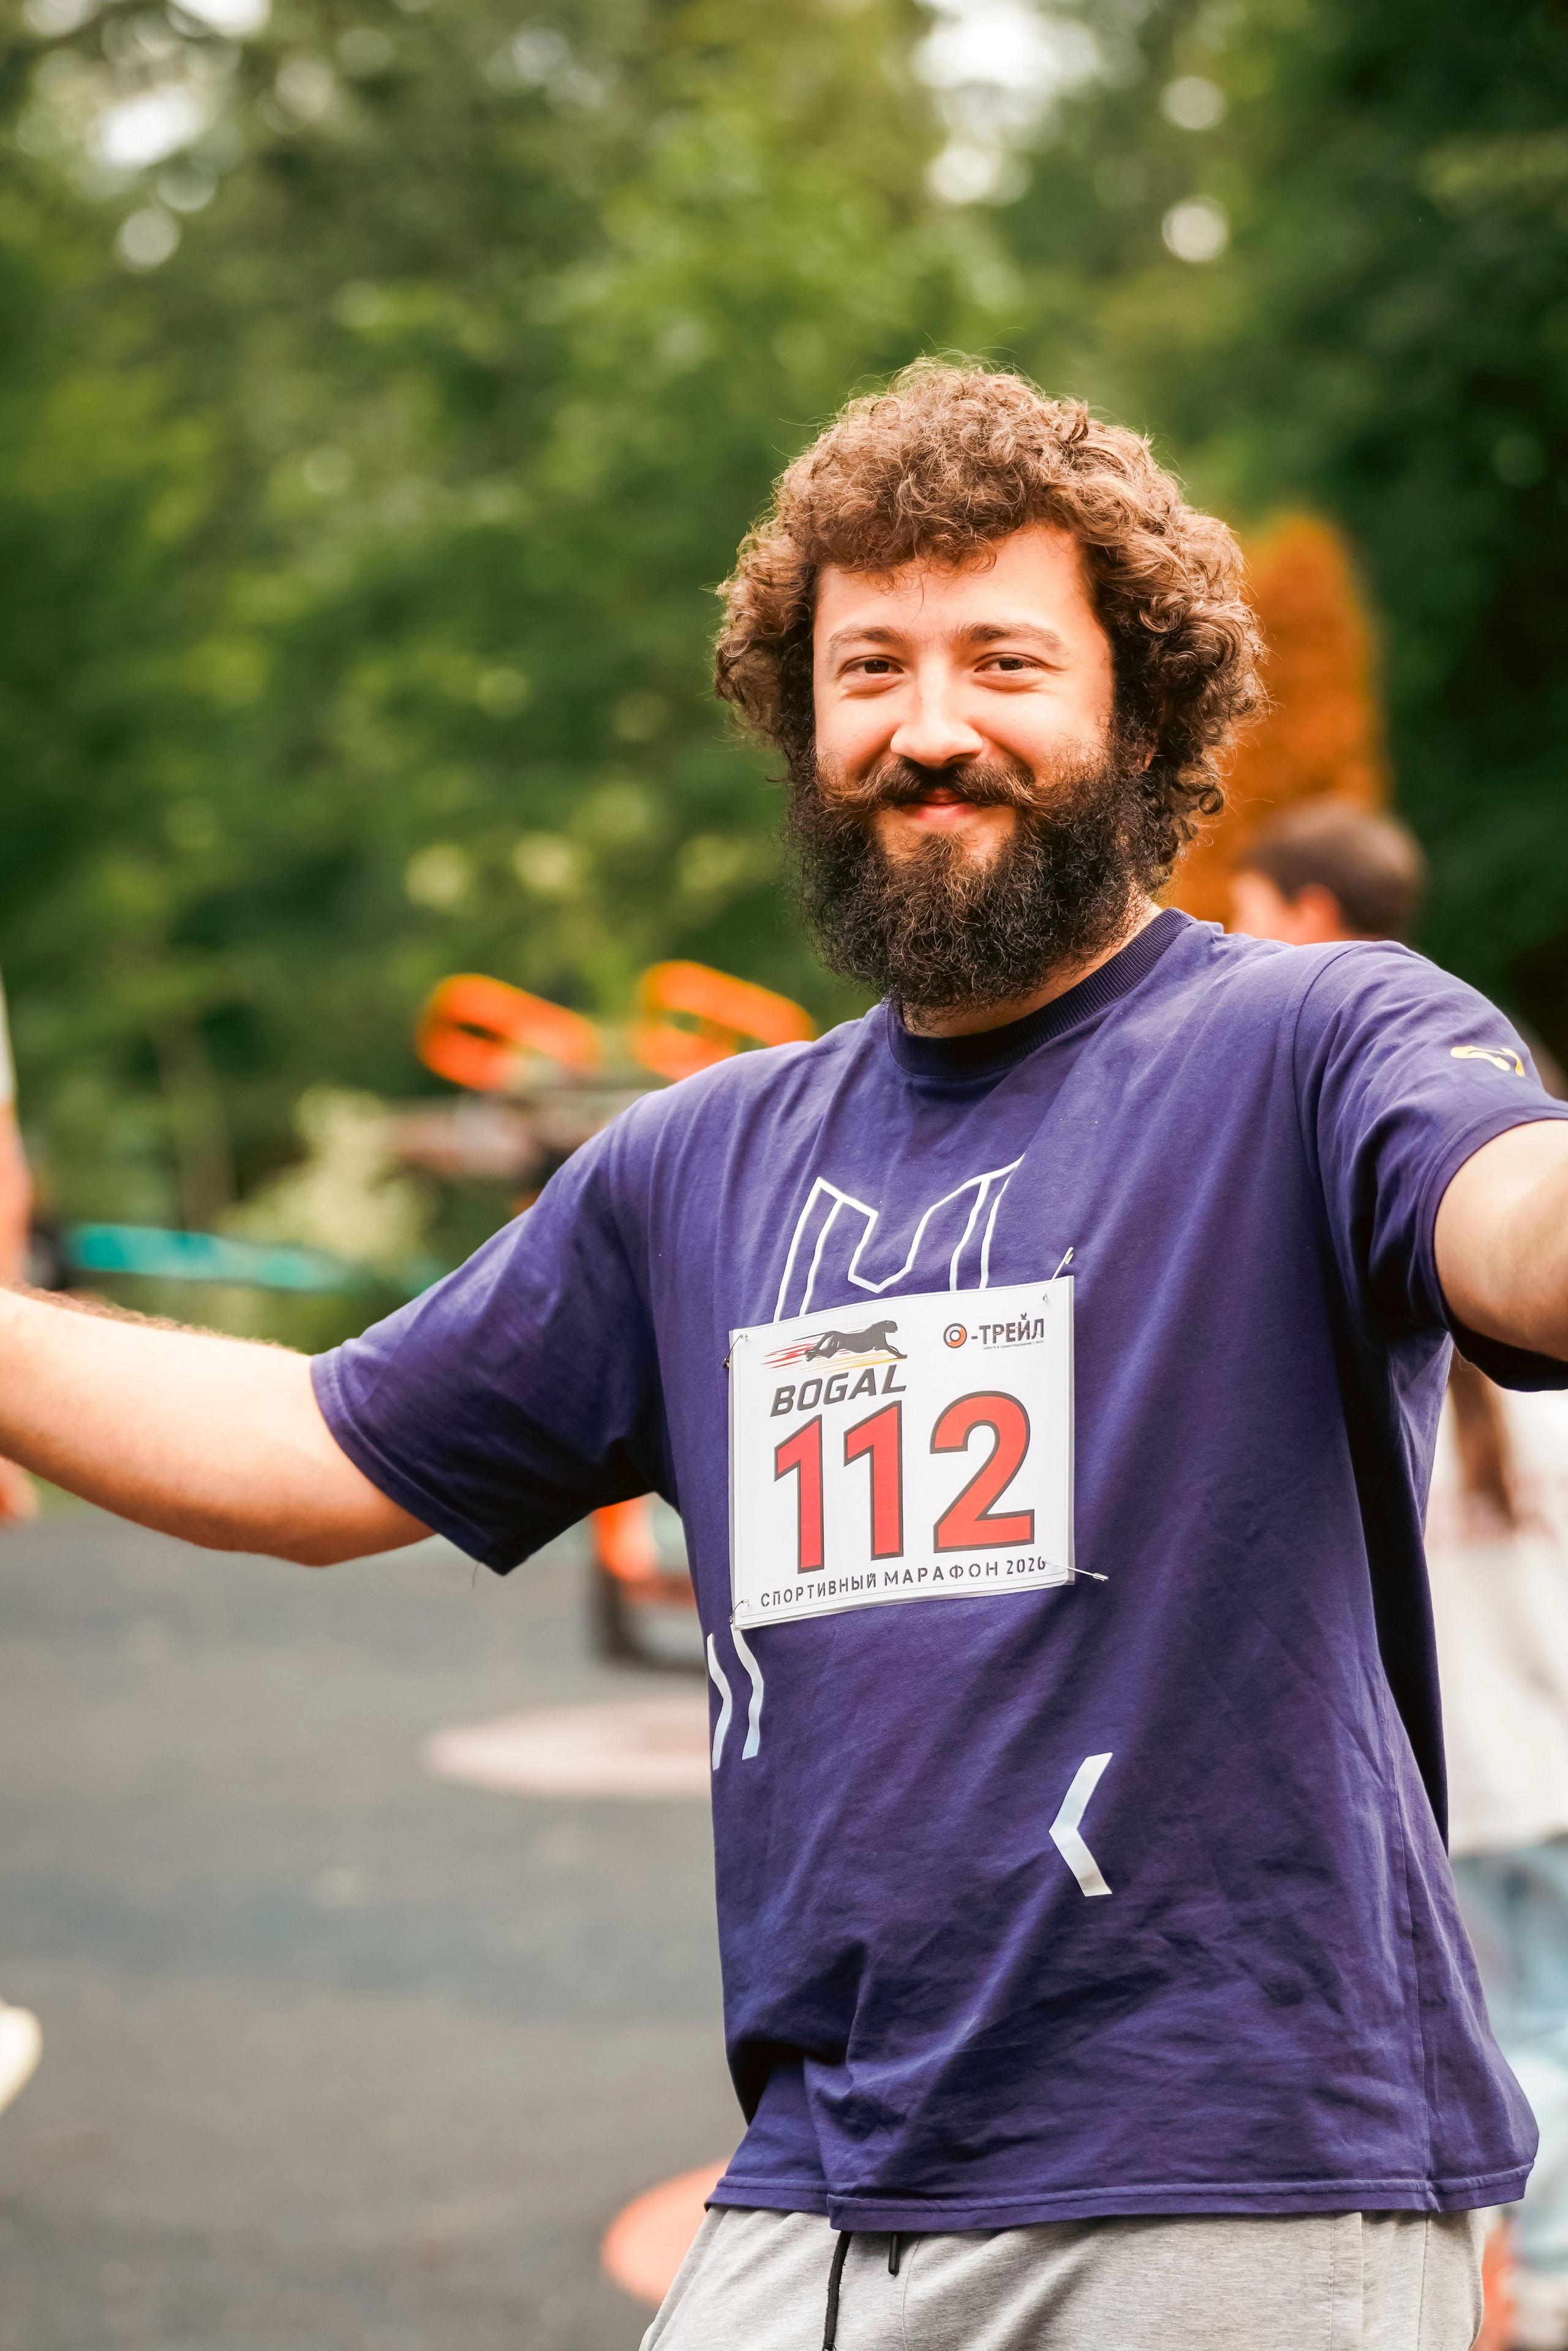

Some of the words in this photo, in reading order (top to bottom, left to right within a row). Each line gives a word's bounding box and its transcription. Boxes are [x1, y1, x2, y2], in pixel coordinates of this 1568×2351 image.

[770, 1364, 907, 1417] BOGAL
[775, 1391, 1035, 1574] 112
[761, 1572, 876, 1607] СПОРТИВНЫЙ
[884, 1561, 998, 1585] МАРАФОН
[1006, 1556, 1046, 1574] 2026
